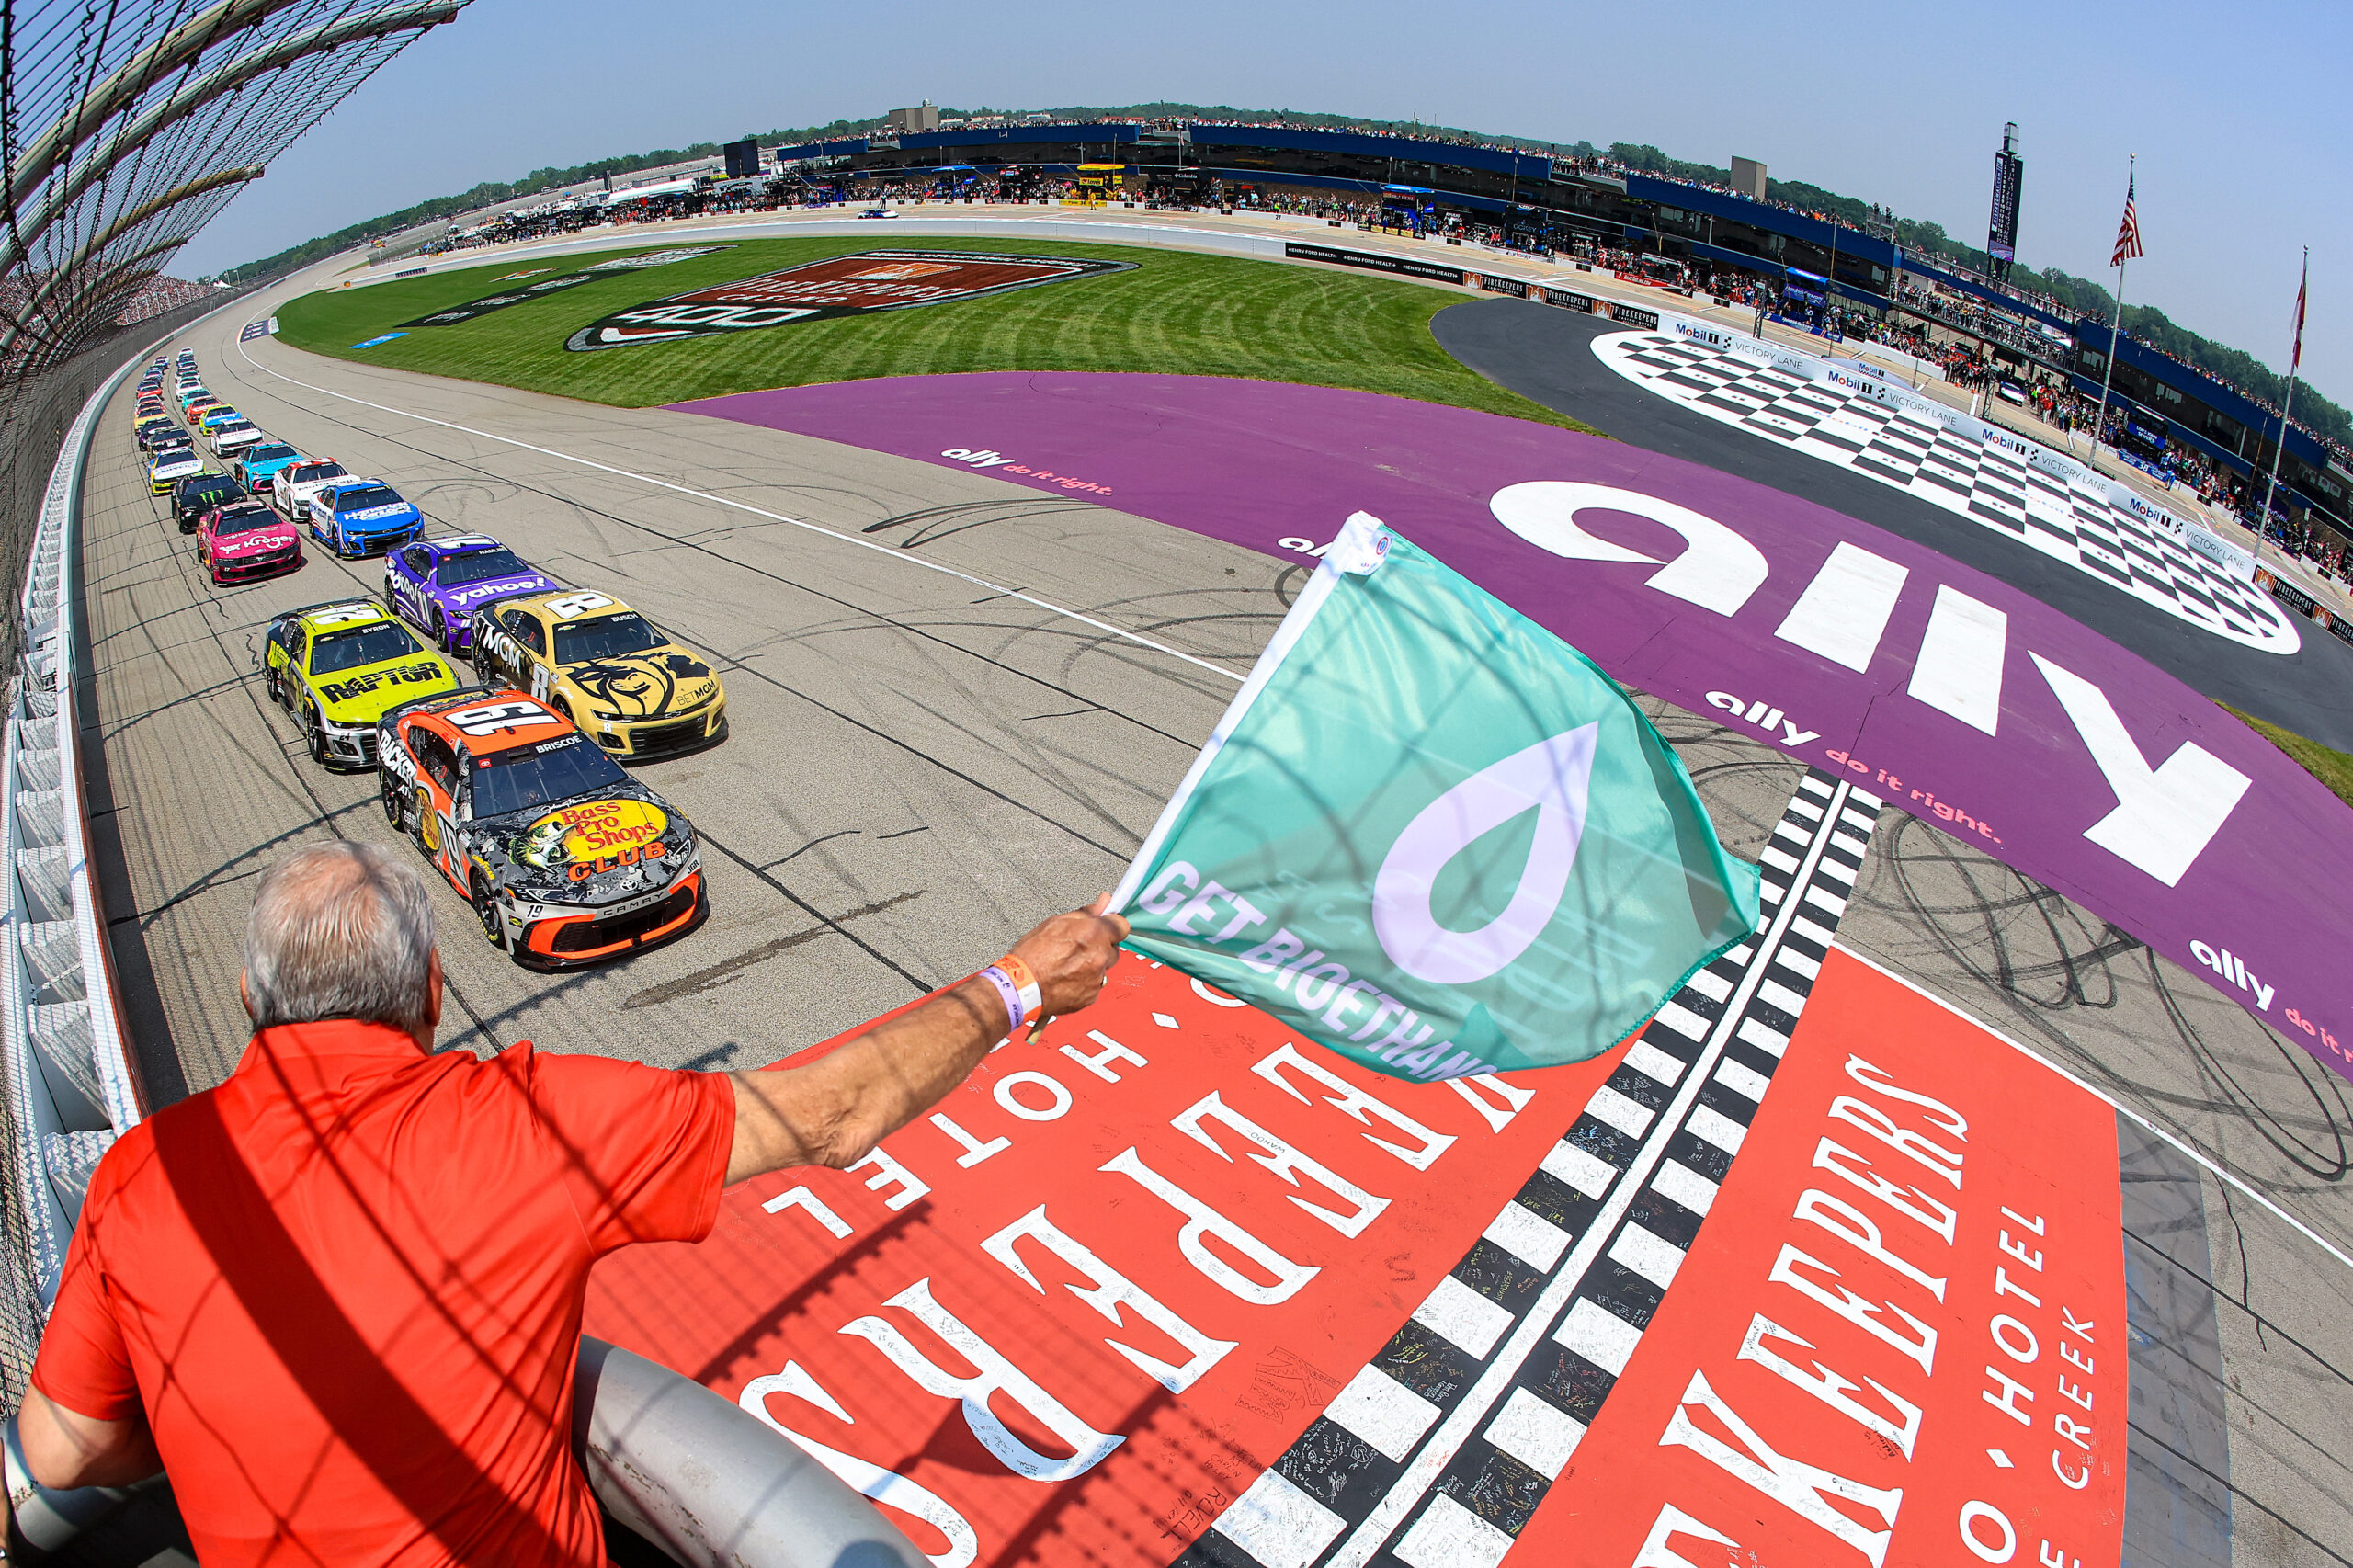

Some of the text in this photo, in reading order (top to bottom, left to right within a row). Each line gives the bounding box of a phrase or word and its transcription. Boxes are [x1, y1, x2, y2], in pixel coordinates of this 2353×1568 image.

[1343, 255, 1360, 263] HENRY
[1375, 260, 1396, 268] HEALTH
[1403, 264, 1421, 272] HENRY
[1436, 270, 1459, 279] HEALTH
[717, 293, 850, 305] CASINO
[611, 304, 821, 328] 400
[1675, 323, 1708, 342] Mobil
[1734, 342, 1803, 370] VICTORY LANE
[1859, 362, 1878, 374] Mobil
[1828, 370, 1860, 391] Mobil
[1889, 393, 1957, 426] VICTORY LANE
[1982, 428, 2014, 451] Mobil
[940, 447, 1114, 496] ally do it right.
[2041, 455, 2107, 494] VICTORY LANE
[2129, 497, 2160, 524] Mobil
[244, 535, 295, 550] Kroger
[478, 546, 505, 555] HAMLIN
[2186, 528, 2245, 571] VICTORY LANE
[449, 576, 546, 606] yahoo!
[543, 591, 616, 619] 8
[362, 623, 390, 634] BYRON
[611, 612, 639, 623] BUSCH
[318, 661, 444, 704] RAPTOR
[530, 662, 550, 705] 8
[676, 679, 717, 707] BETMGM
[1490, 480, 2253, 887] ally
[443, 701, 561, 737] 19
[603, 722, 612, 733] 8
[379, 728, 418, 789] TRACKER
[535, 735, 583, 754] BRISCOE
[1704, 690, 2002, 844] ally do it right.
[559, 800, 621, 826] Bass
[574, 814, 620, 837] Pro
[586, 822, 662, 851] Shops
[567, 841, 667, 883] CLUB
[688, 859, 701, 872] JGR
[526, 904, 545, 919] 19
[603, 892, 665, 917] CAMRY
[1138, 859, 1268, 945] GET
[2189, 939, 2341, 1056] ally do it
[761, 1029, 1150, 1239] HOTEL
[1981, 1205, 2045, 1426] HOTEL
[2052, 1304, 2097, 1491] CREEK
